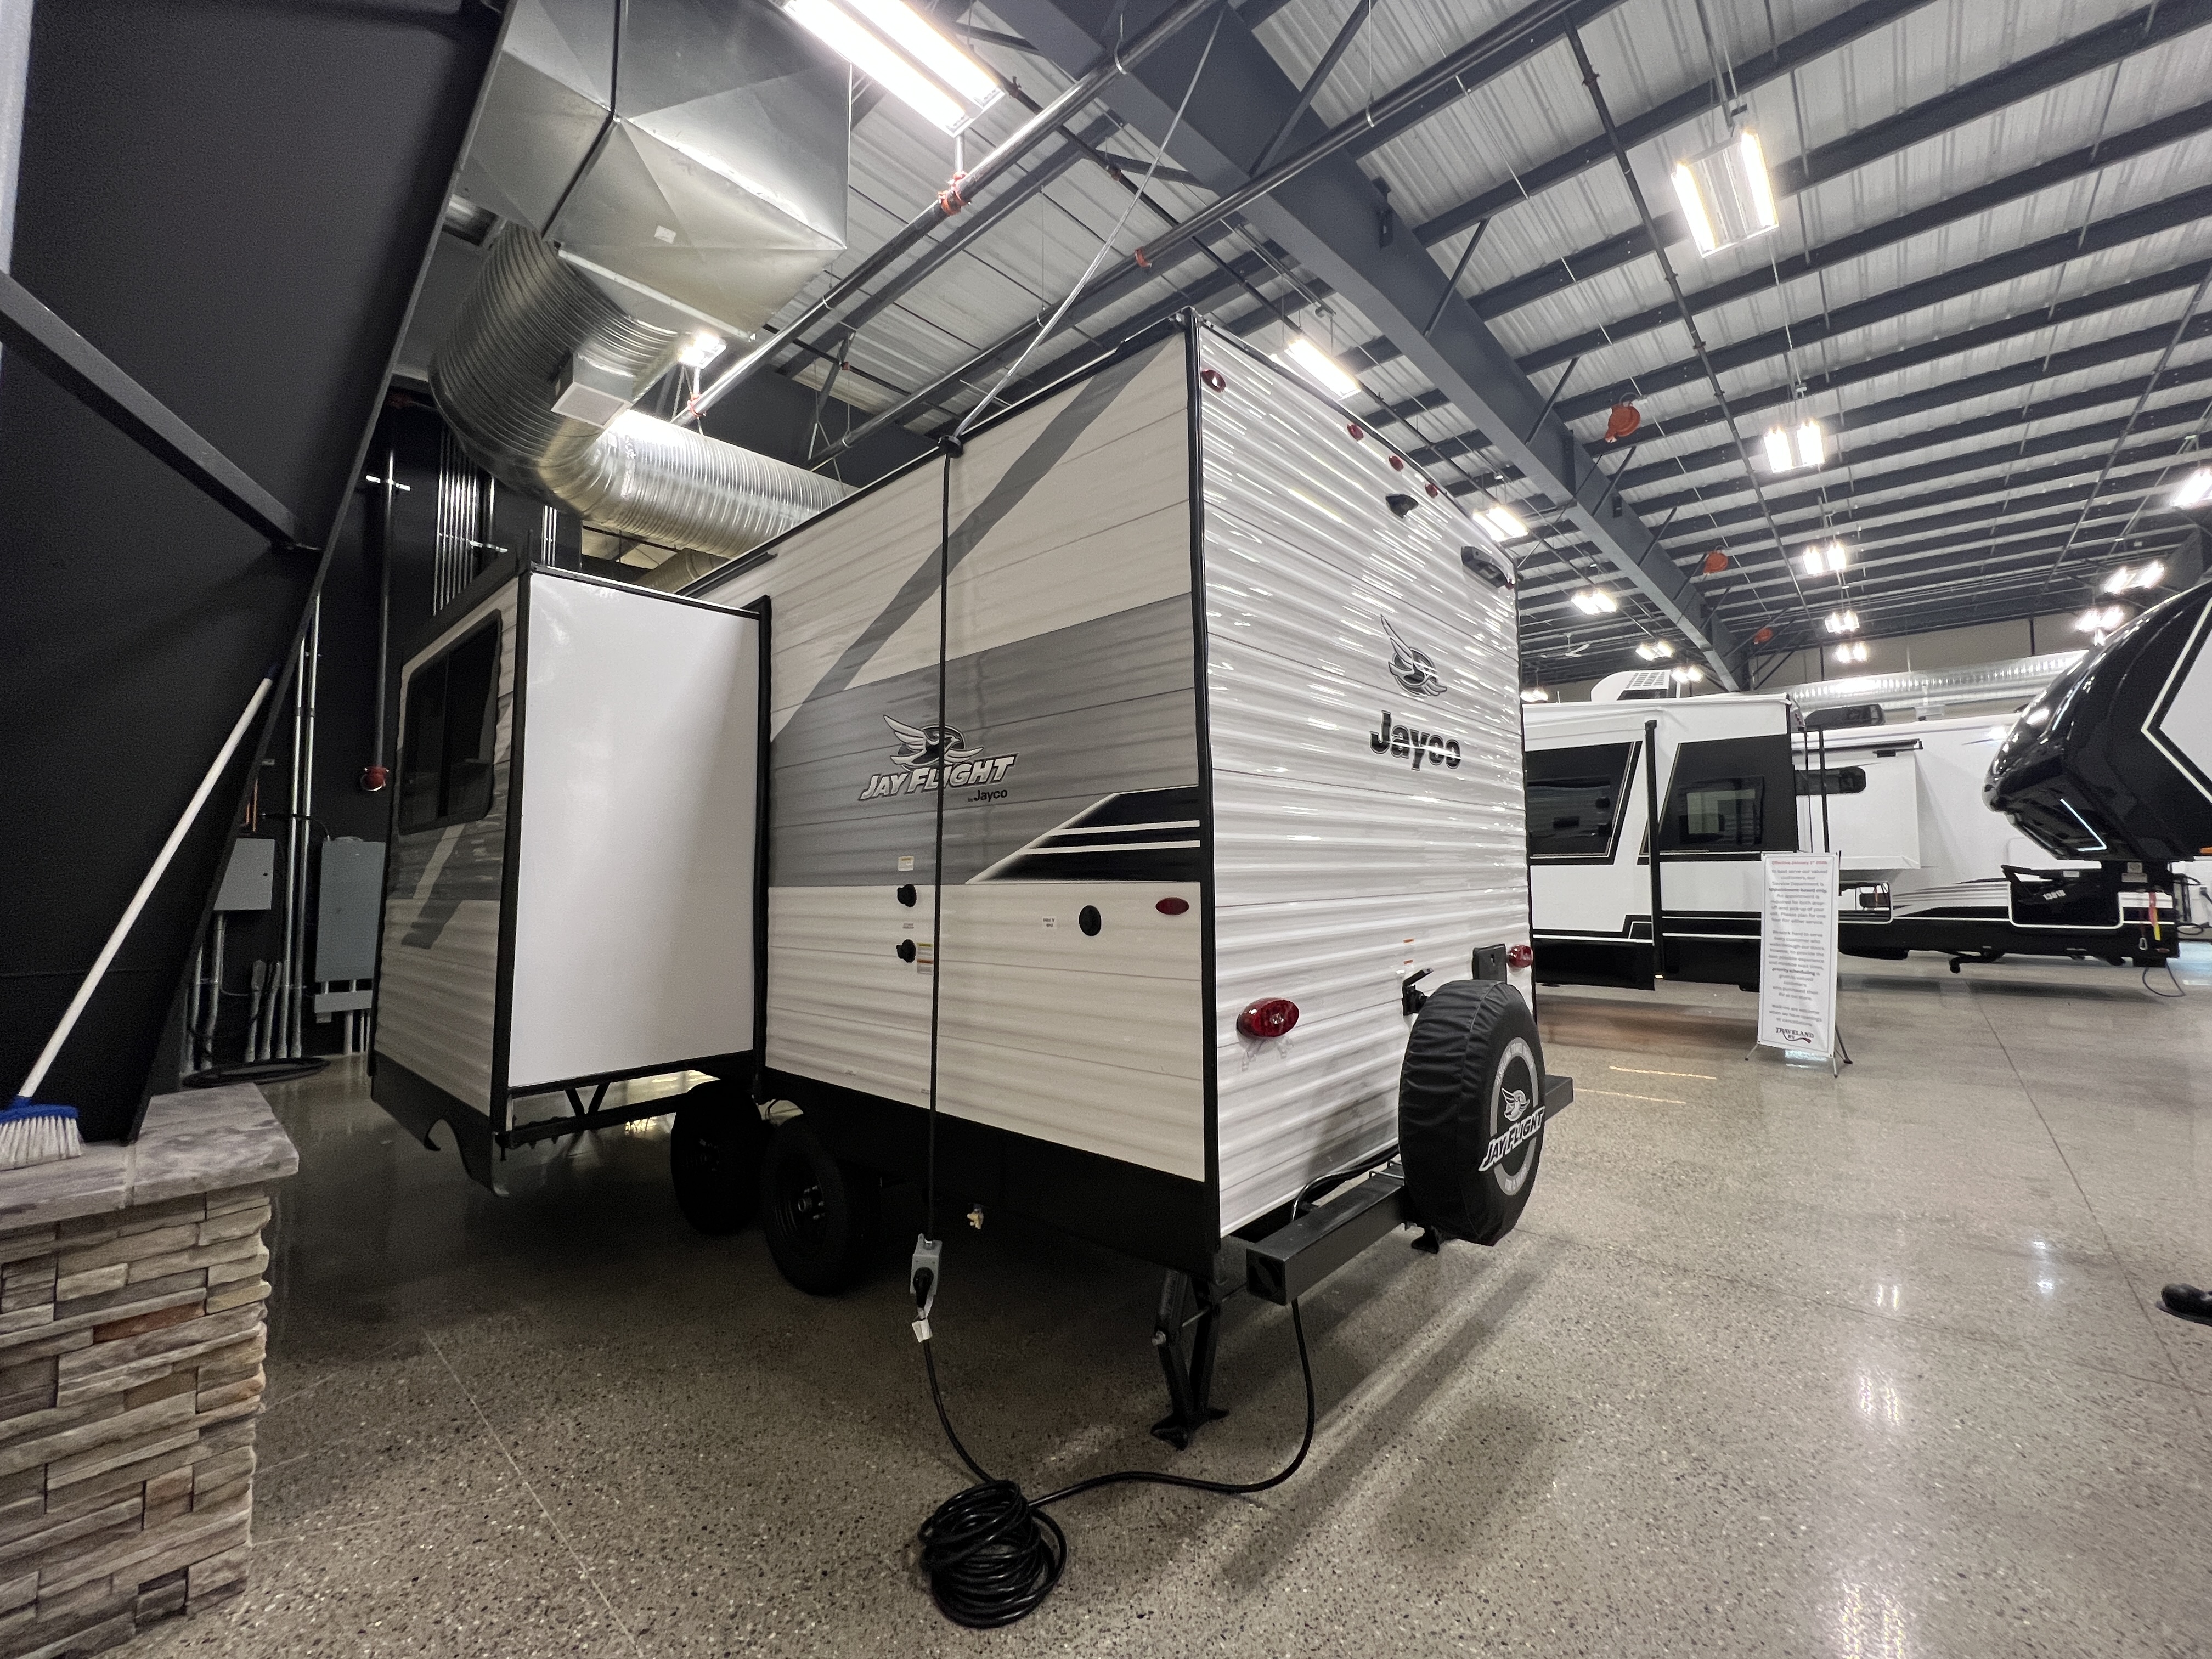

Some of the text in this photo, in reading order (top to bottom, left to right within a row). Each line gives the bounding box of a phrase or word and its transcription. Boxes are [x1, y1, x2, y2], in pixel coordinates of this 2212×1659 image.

[1369, 710, 1462, 771] Jayco
[858, 752, 1018, 800] JAY FLIGHT
[973, 789, 1008, 803] Jayco
[1776, 1027, 1814, 1038] TRAVELAND
